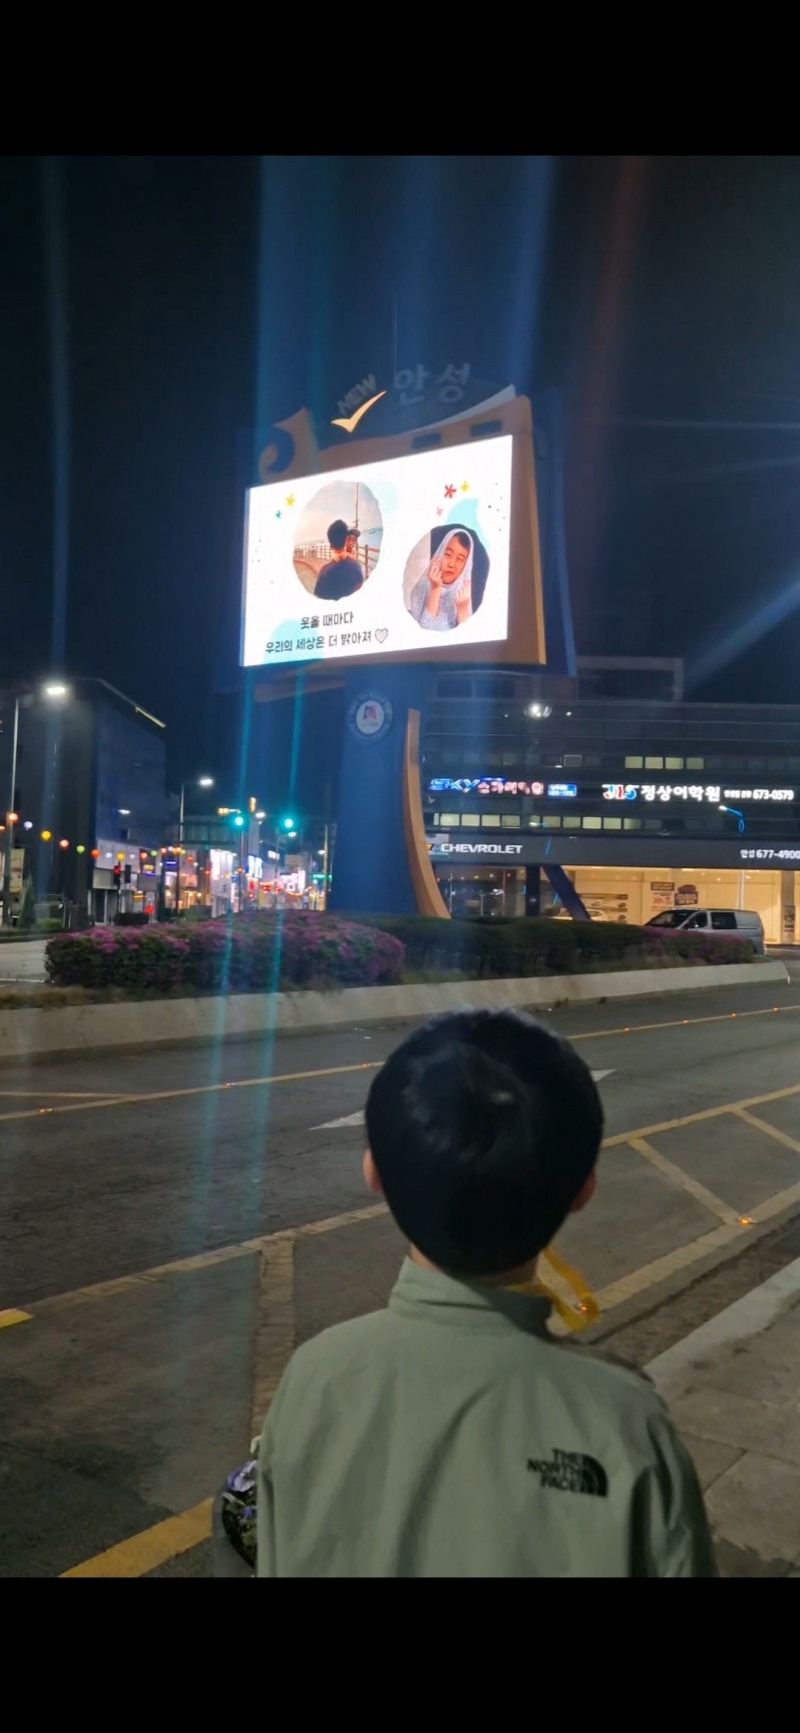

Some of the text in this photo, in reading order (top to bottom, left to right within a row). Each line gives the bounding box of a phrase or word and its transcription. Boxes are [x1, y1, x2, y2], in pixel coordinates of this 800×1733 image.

[394, 363, 471, 405] 안성
[337, 373, 376, 415] NEW
[322, 611, 354, 626] 때마다
[265, 631, 372, 653] 우리의 세상은 더 밝아져
[641, 784, 720, 801] 정상어학원
[441, 843, 523, 854] CHEVROLET
